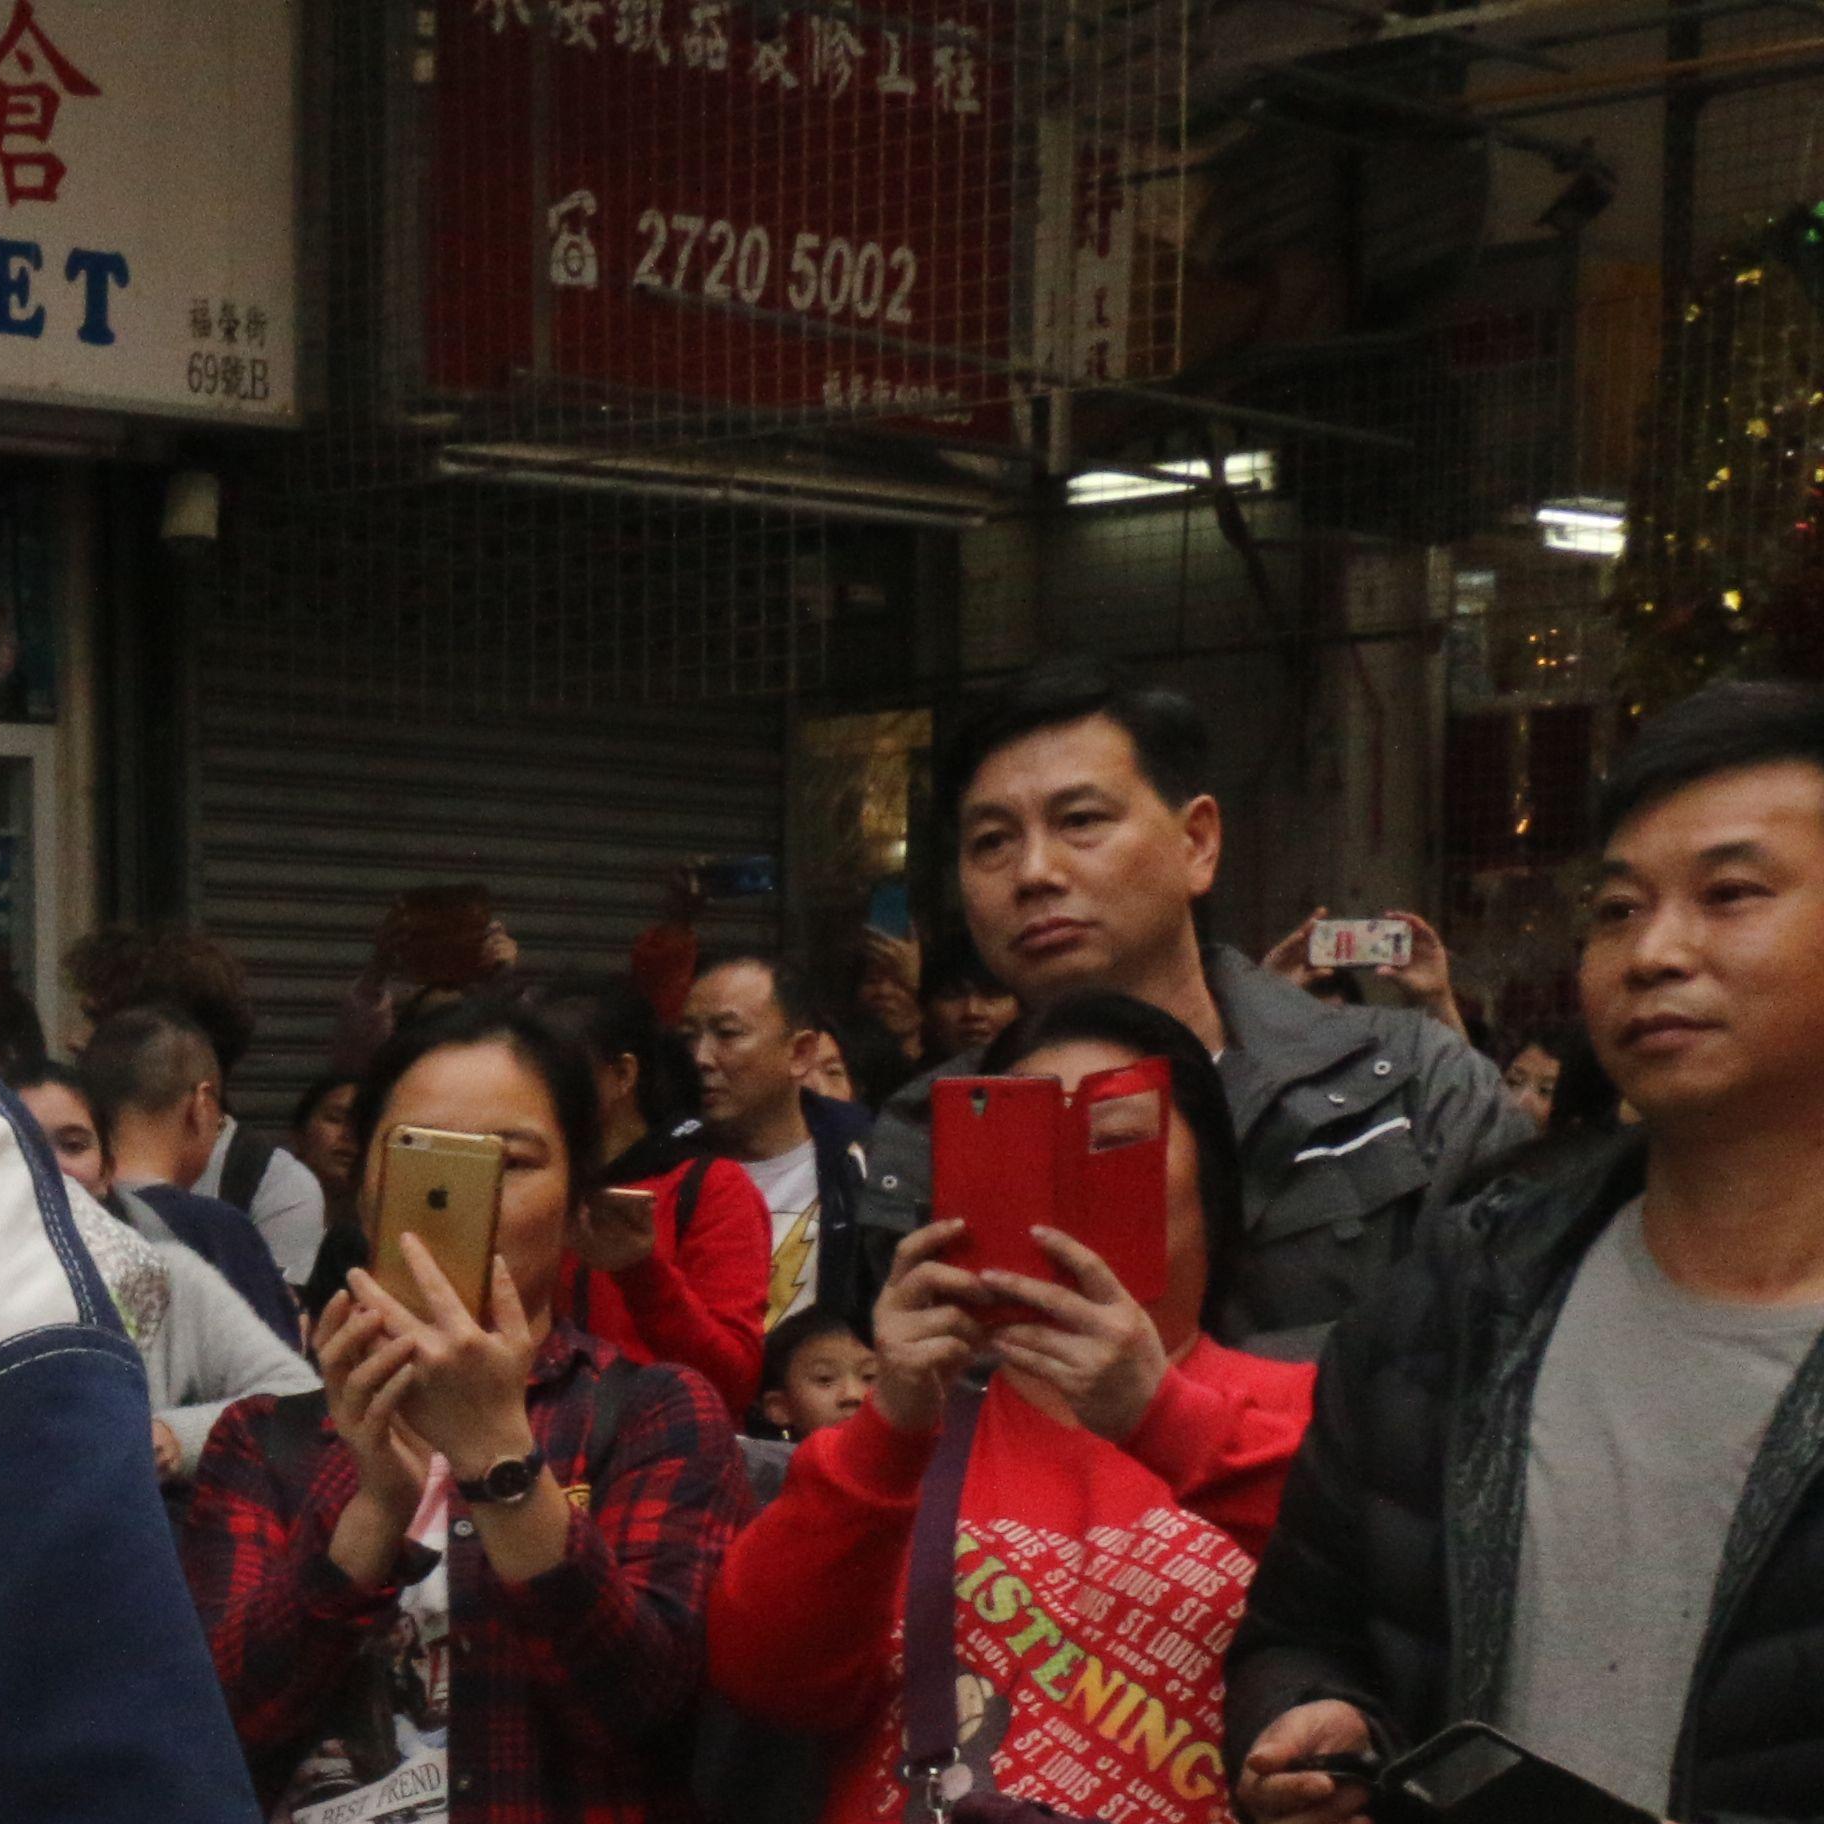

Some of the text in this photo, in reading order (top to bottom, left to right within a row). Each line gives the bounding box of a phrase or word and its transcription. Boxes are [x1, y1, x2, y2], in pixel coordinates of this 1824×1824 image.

[633, 208, 918, 324] 2720 5002
[1159, 1553, 1229, 1599] LOUIS
[1038, 1750, 1103, 1802] LOUIS
